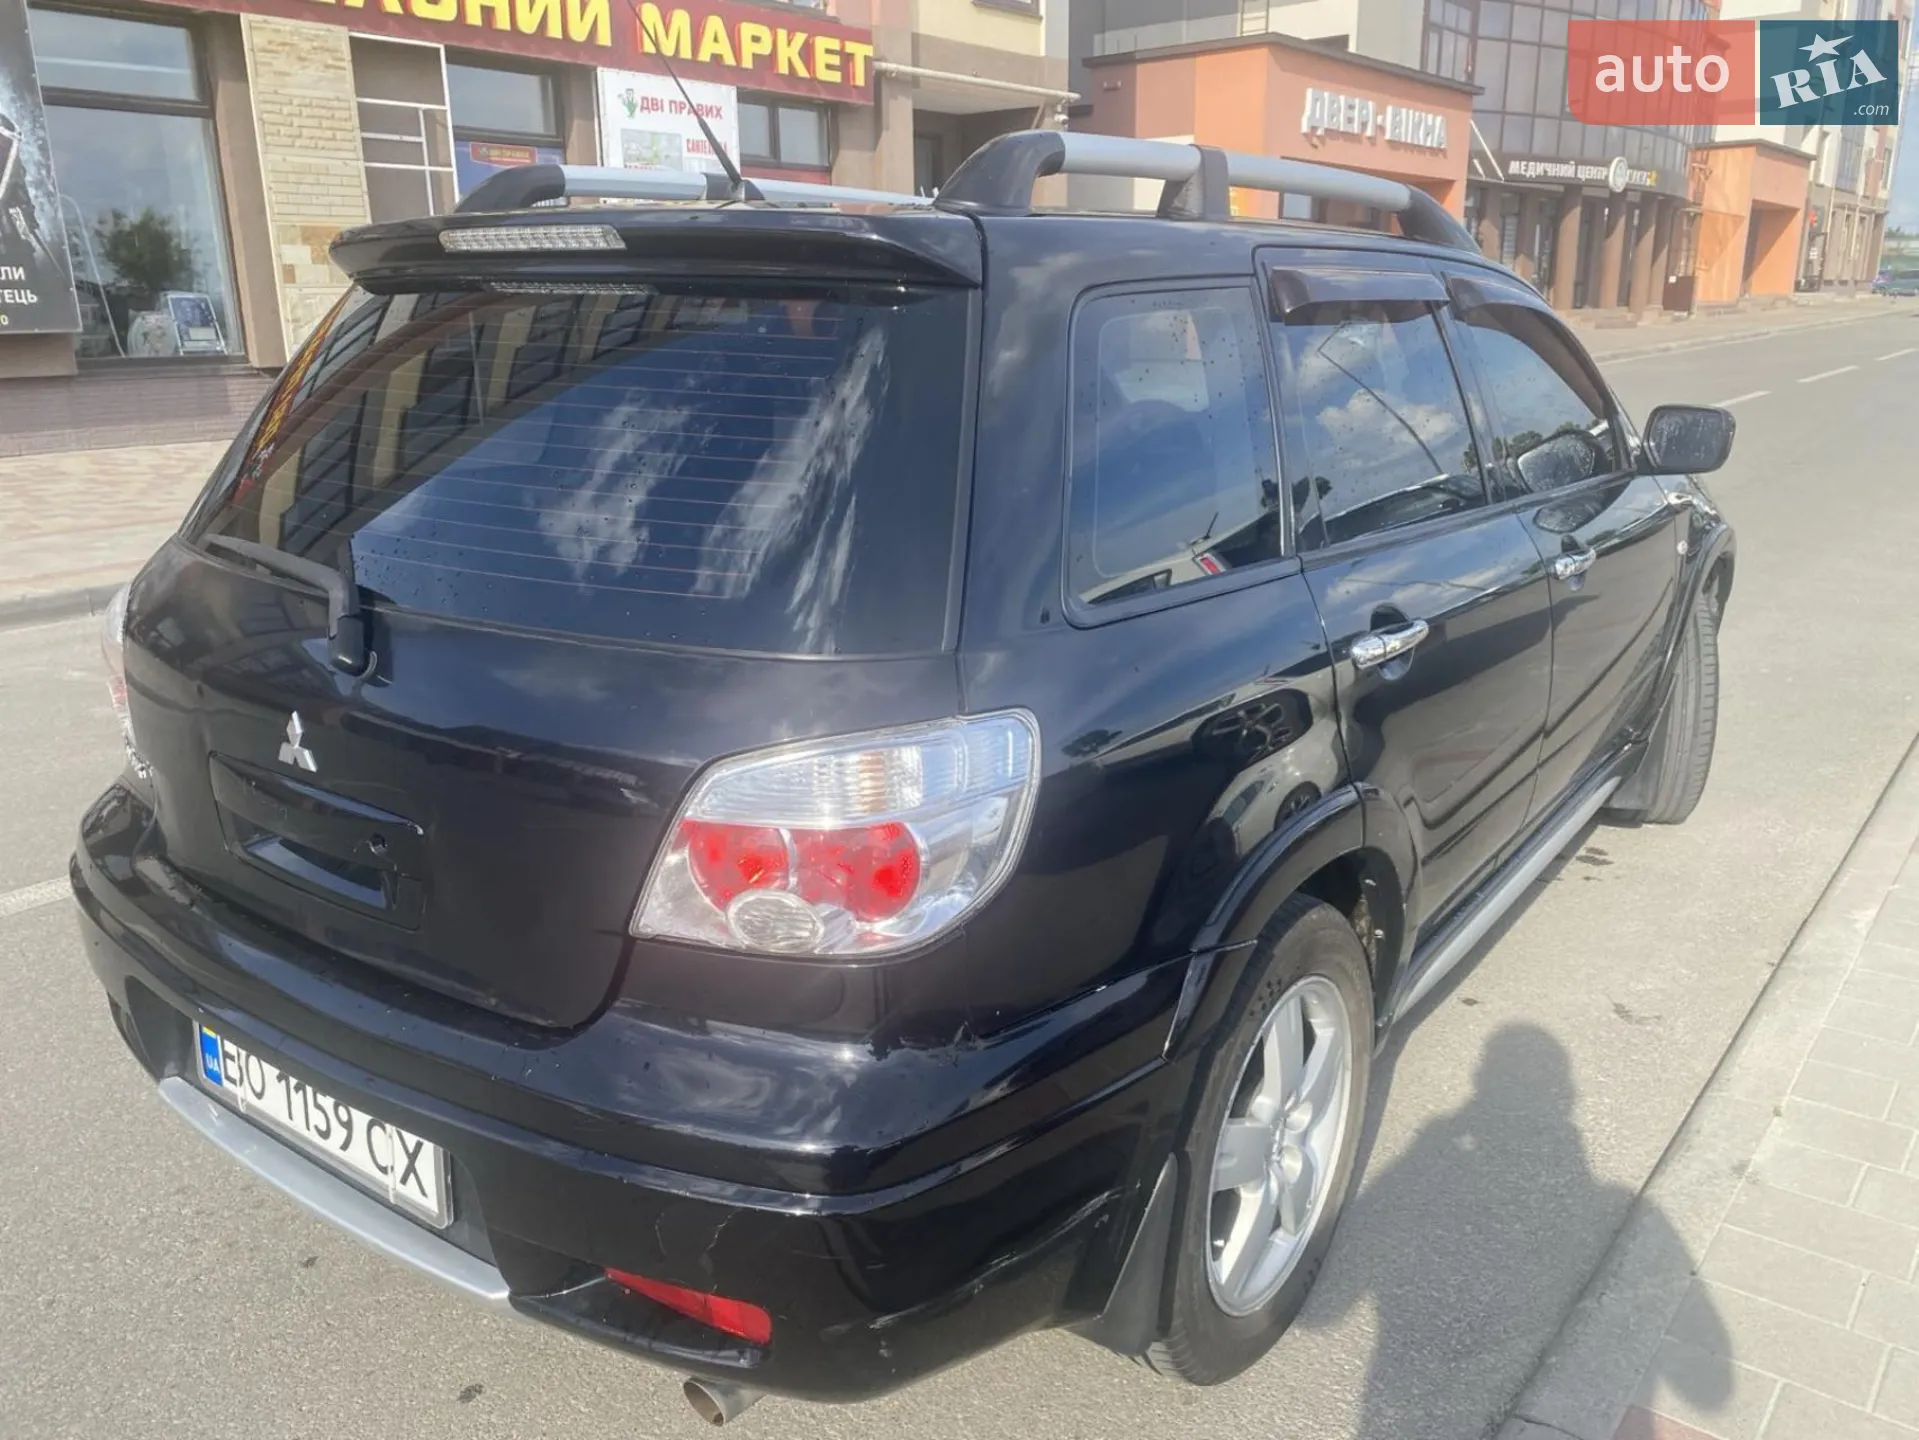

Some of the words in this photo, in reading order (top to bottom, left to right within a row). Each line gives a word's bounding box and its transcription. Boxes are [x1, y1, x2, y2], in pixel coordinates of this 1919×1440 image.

[637, 2, 873, 87] МАРКЕТ
[640, 96, 664, 114] ДВІ
[668, 99, 723, 119] ПРАВИХ
[1508, 160, 1576, 179] МЕДИЧНИЙ
[1577, 164, 1609, 182] ЦЕНТР
[0, 289, 38, 305] ЕЦЬ
[205, 1053, 220, 1073] UA
[276, 1070, 354, 1151] 1159
[366, 1118, 428, 1199] CX
